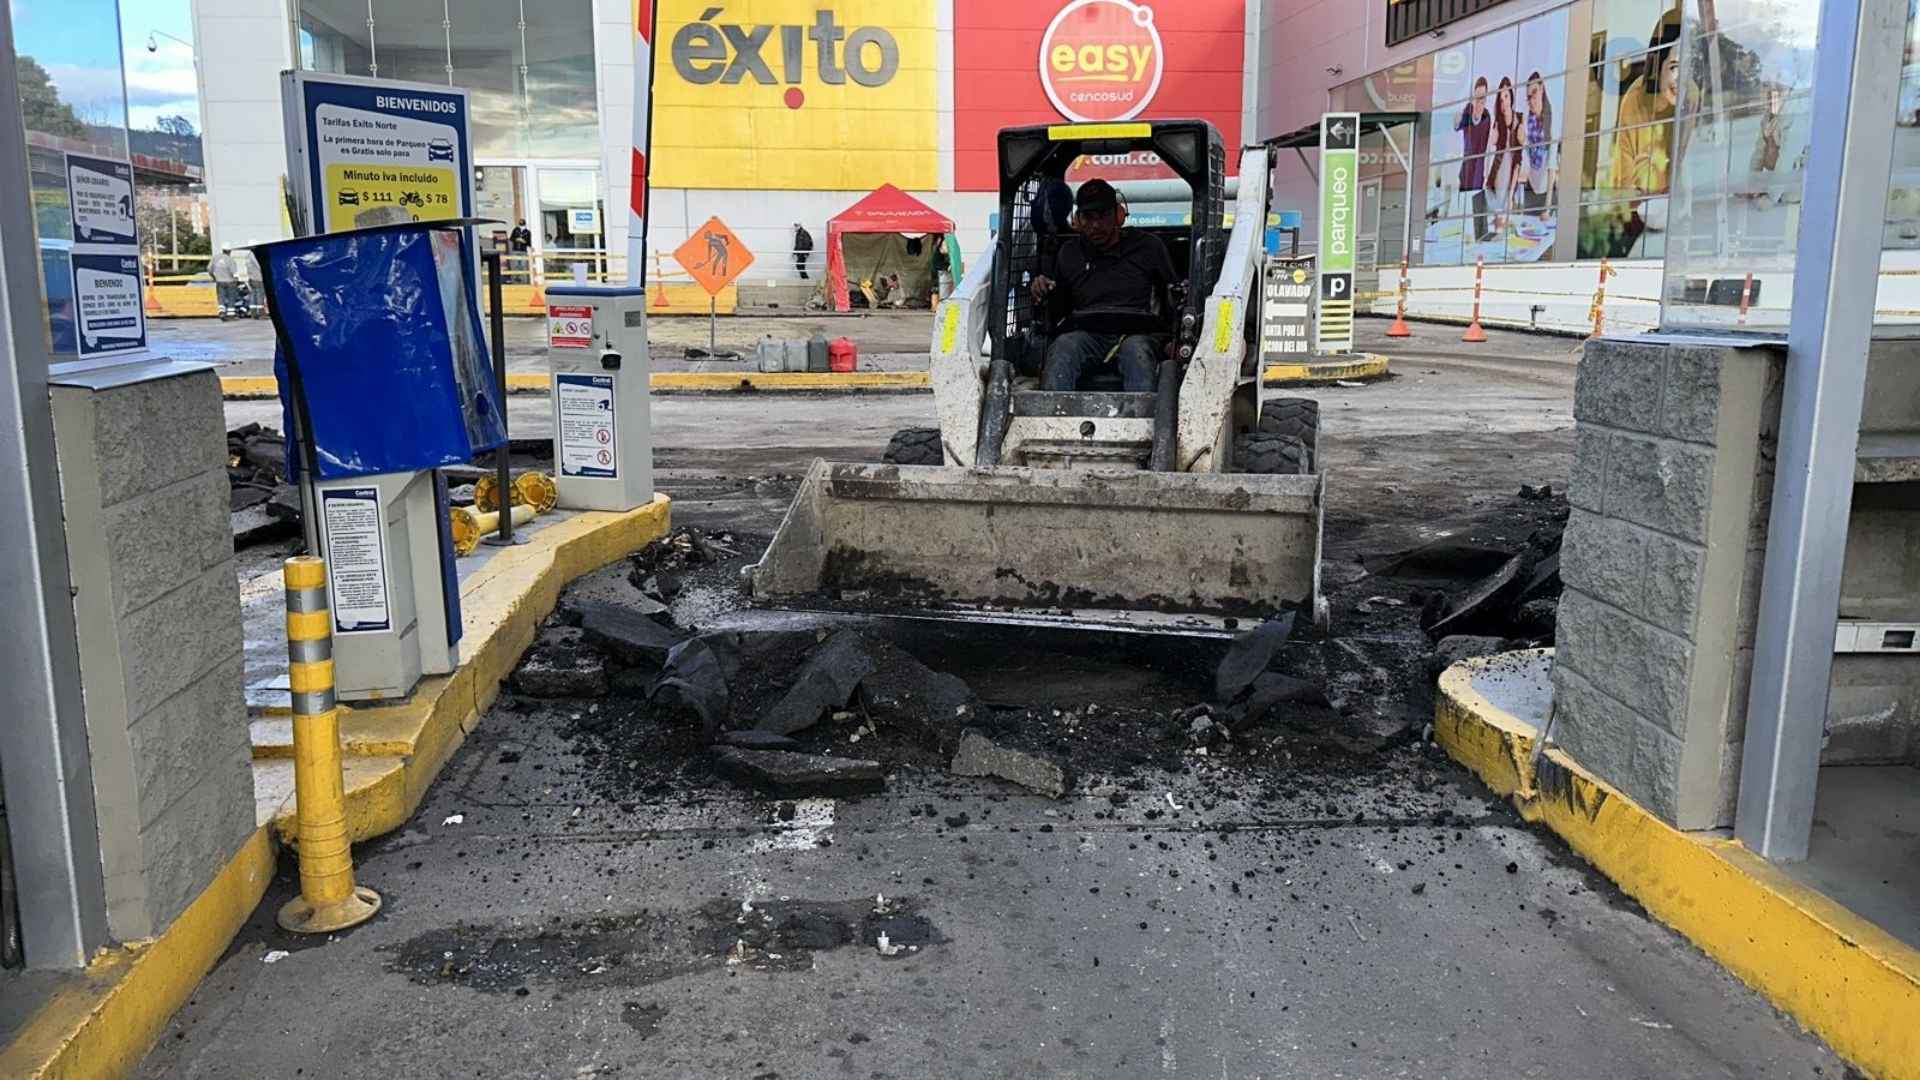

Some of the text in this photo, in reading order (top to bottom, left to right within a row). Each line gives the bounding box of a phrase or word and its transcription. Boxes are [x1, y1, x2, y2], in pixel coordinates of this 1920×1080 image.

[1051, 41, 1153, 82] easy
[1069, 88, 1134, 102] cencosud
[376, 95, 457, 114] BIENVENIDOS
[322, 117, 351, 128] Tarifas
[375, 121, 398, 131] Norte
[323, 135, 426, 150] La primera hora de Parqueo
[352, 147, 375, 156] Gratis
[393, 150, 410, 159] para
[343, 170, 438, 184] Minuto iva incluido
[362, 191, 393, 202] $ 111
[425, 193, 448, 205] $ 78
[1331, 167, 1351, 255] parqueo
[1330, 276, 1346, 297] p
